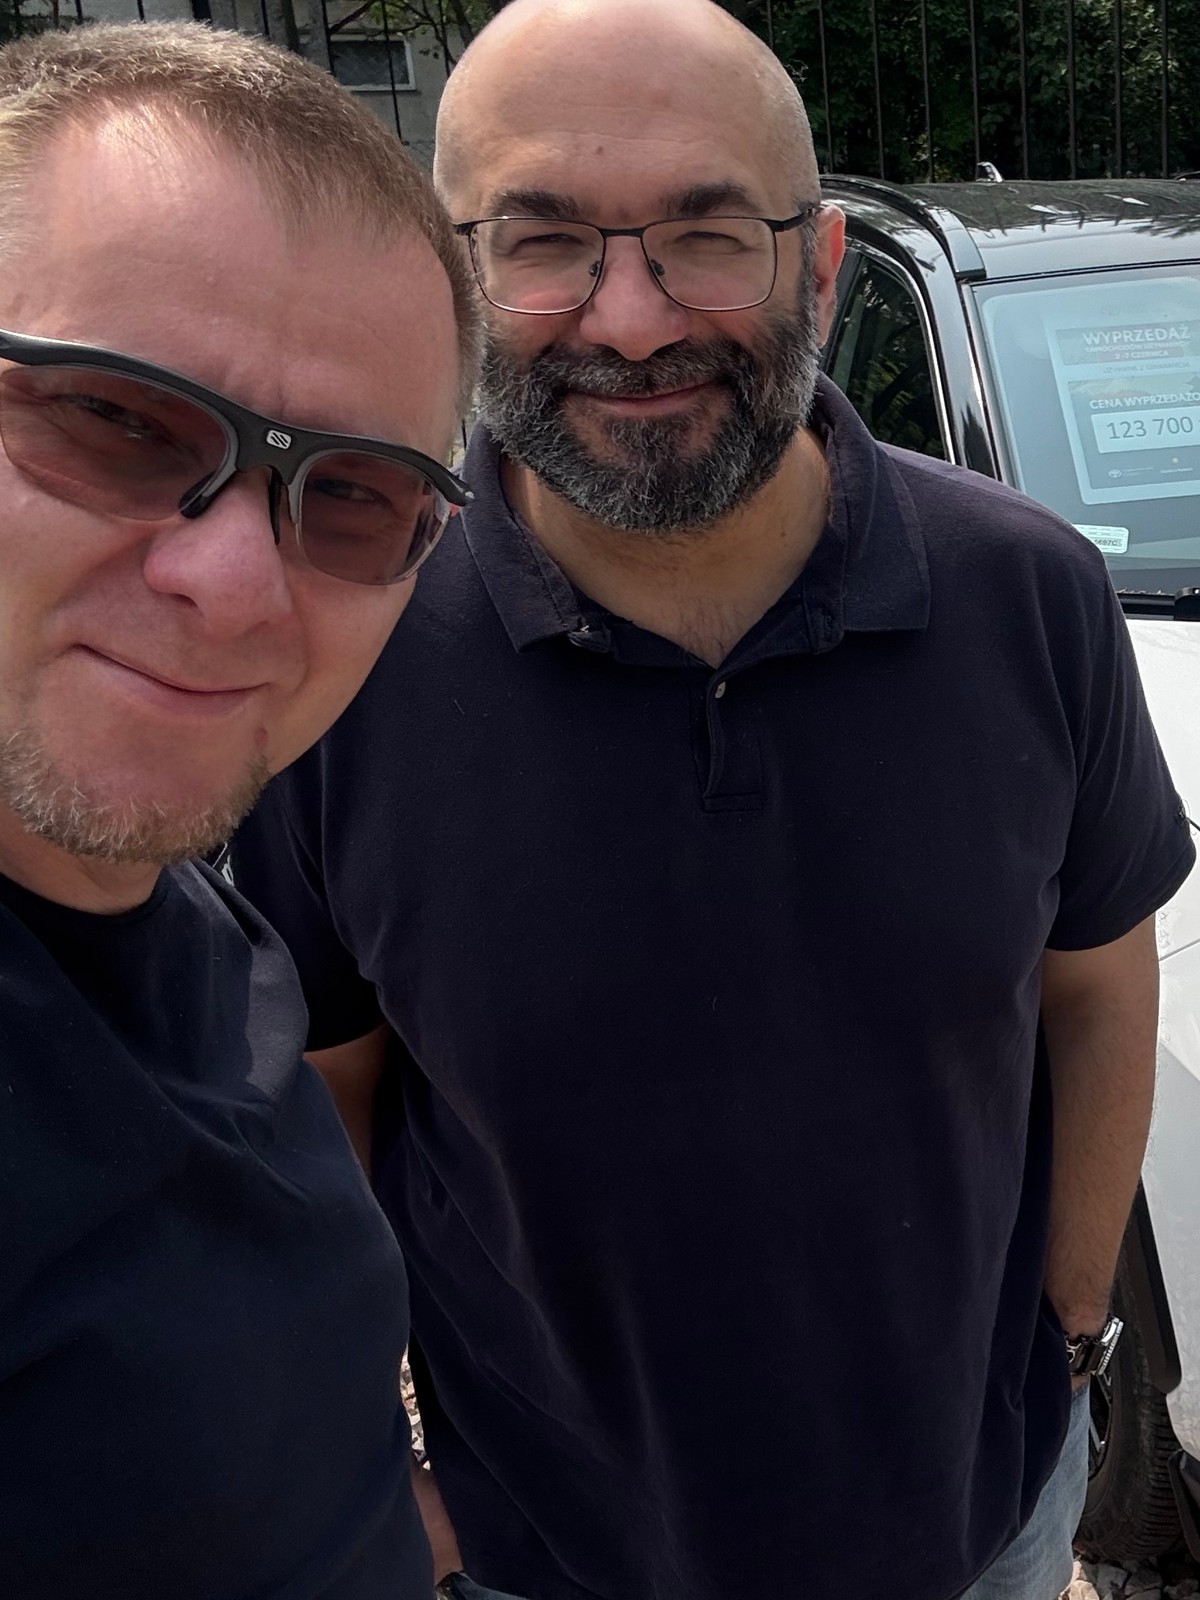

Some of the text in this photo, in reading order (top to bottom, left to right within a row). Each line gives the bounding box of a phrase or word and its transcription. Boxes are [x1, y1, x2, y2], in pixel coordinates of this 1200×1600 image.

[1082, 323, 1192, 346] WYPRZEDAŻ
[1089, 398, 1123, 410] CENA
[1107, 419, 1147, 440] 123
[1152, 416, 1194, 436] 700
